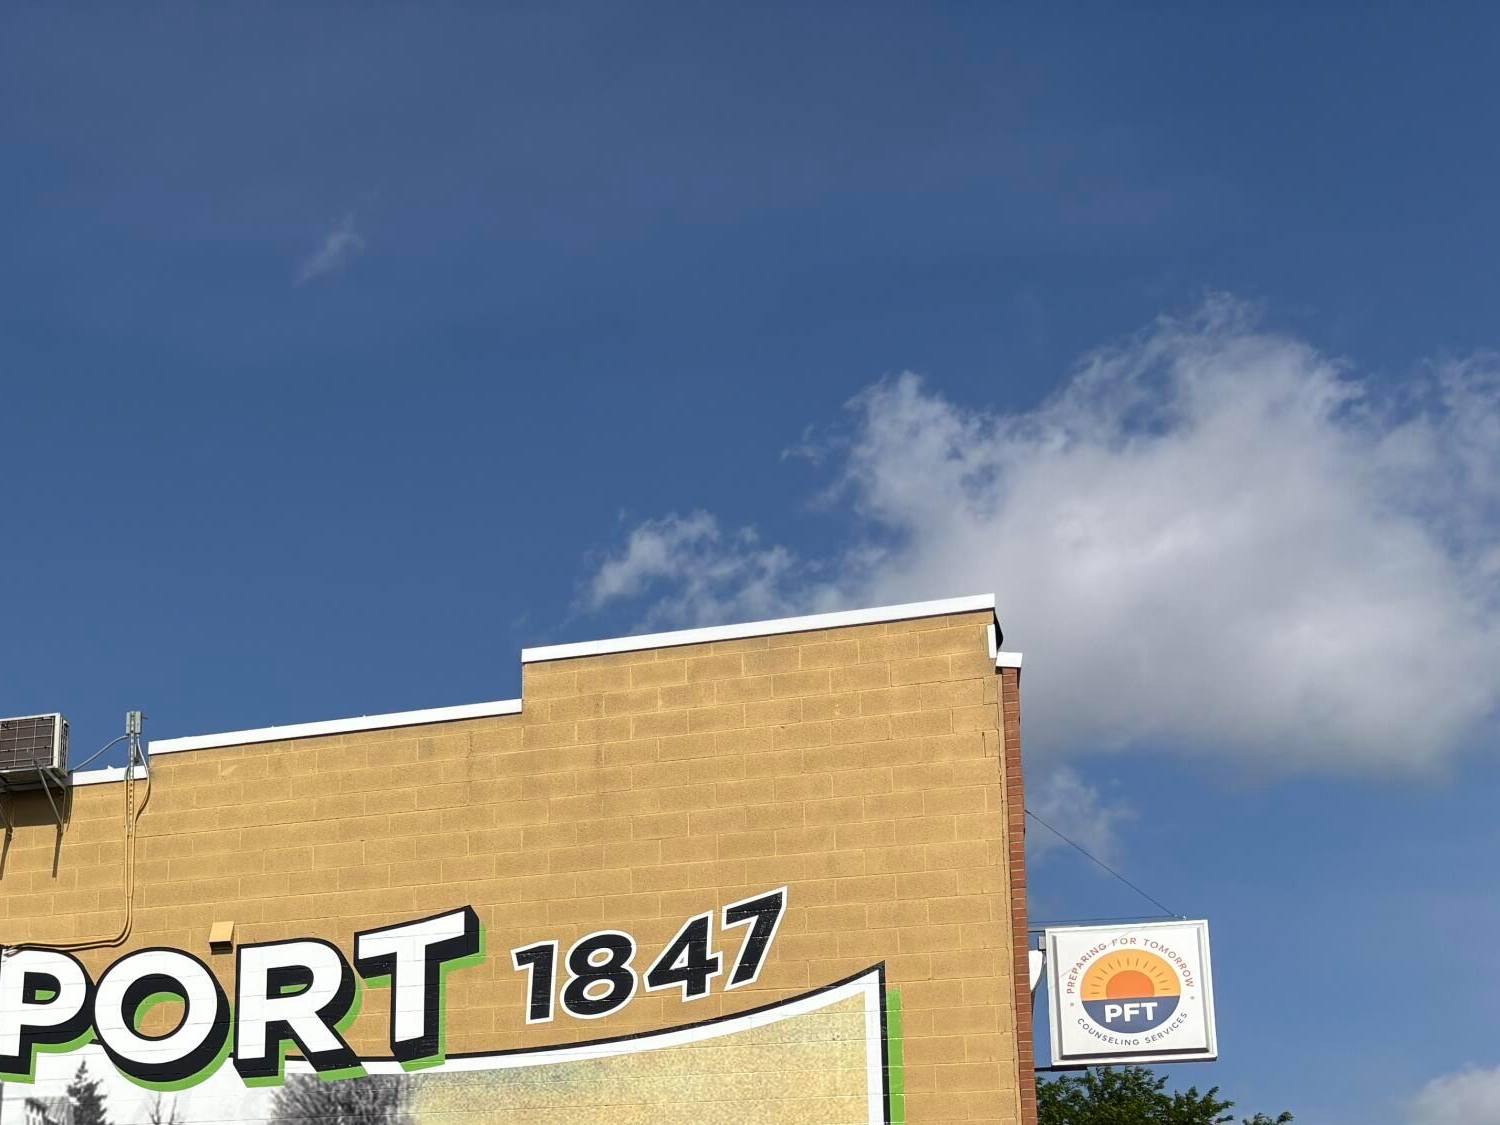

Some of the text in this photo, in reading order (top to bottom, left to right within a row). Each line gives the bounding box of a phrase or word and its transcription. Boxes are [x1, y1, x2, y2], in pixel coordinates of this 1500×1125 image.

[511, 886, 787, 1024] 1847
[1067, 937, 1195, 994] PREPARING FOR TOMORROW
[1077, 1012, 1187, 1046] COUNSELING SERVICES
[1104, 1001, 1158, 1023] PFT
